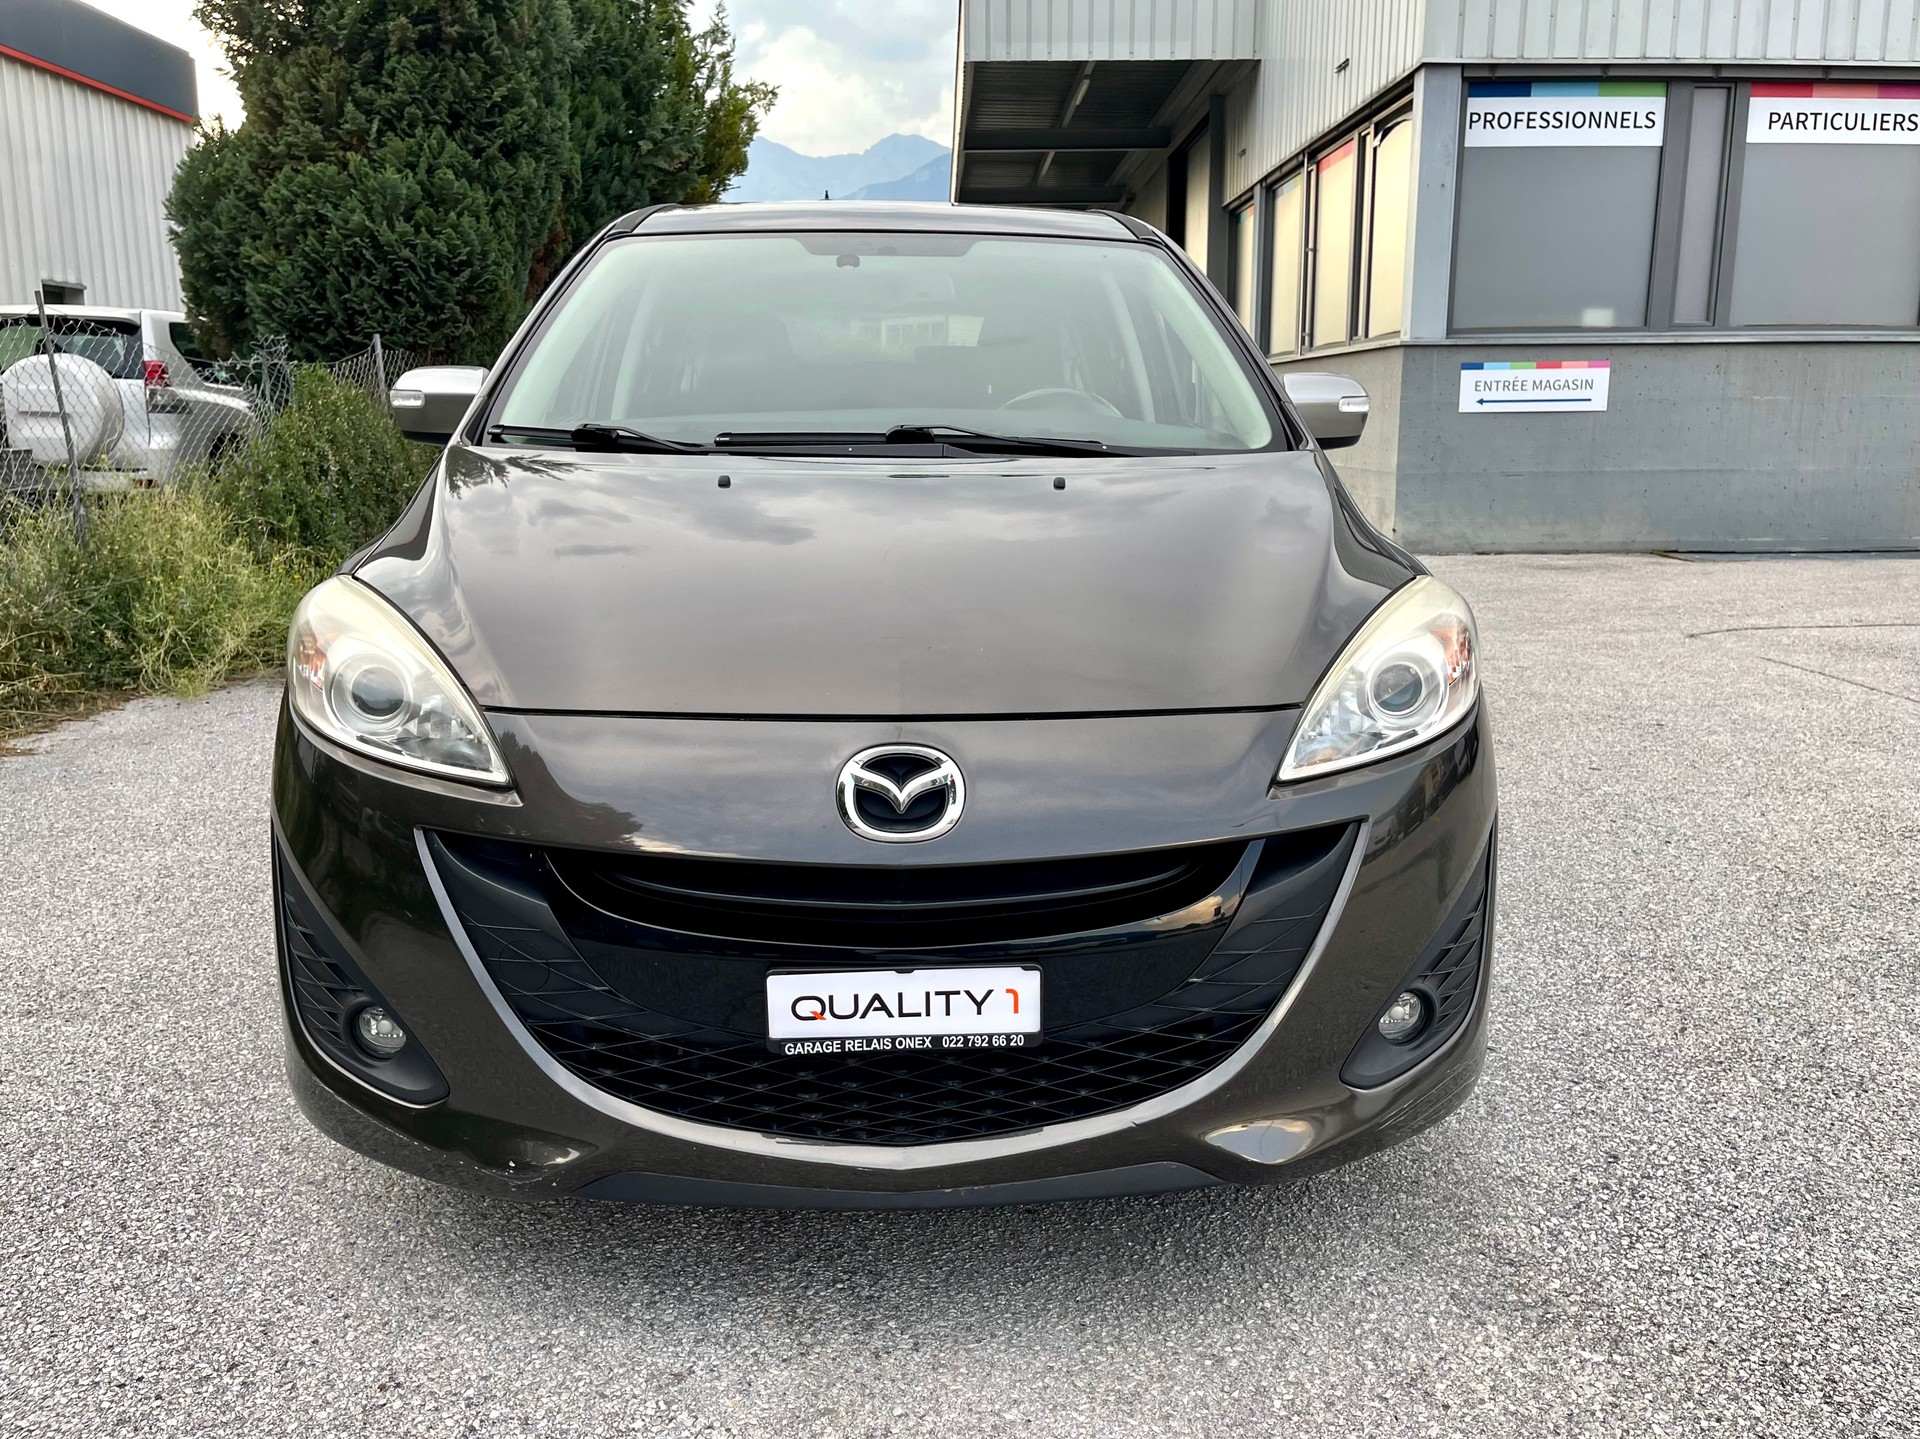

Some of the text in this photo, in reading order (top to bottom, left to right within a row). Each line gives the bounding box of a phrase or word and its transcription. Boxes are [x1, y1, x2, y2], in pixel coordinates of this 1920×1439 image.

[1468, 111, 1656, 131] PROFESSIONNELS
[1768, 112, 1919, 132] PARTICULIERS
[1474, 376, 1594, 392] ENTRÉE MAGASIN
[791, 988, 1019, 1021] QUALITY 1
[784, 1034, 1024, 1055] GARAGE RELAIS ONEX 022 792 66 20
